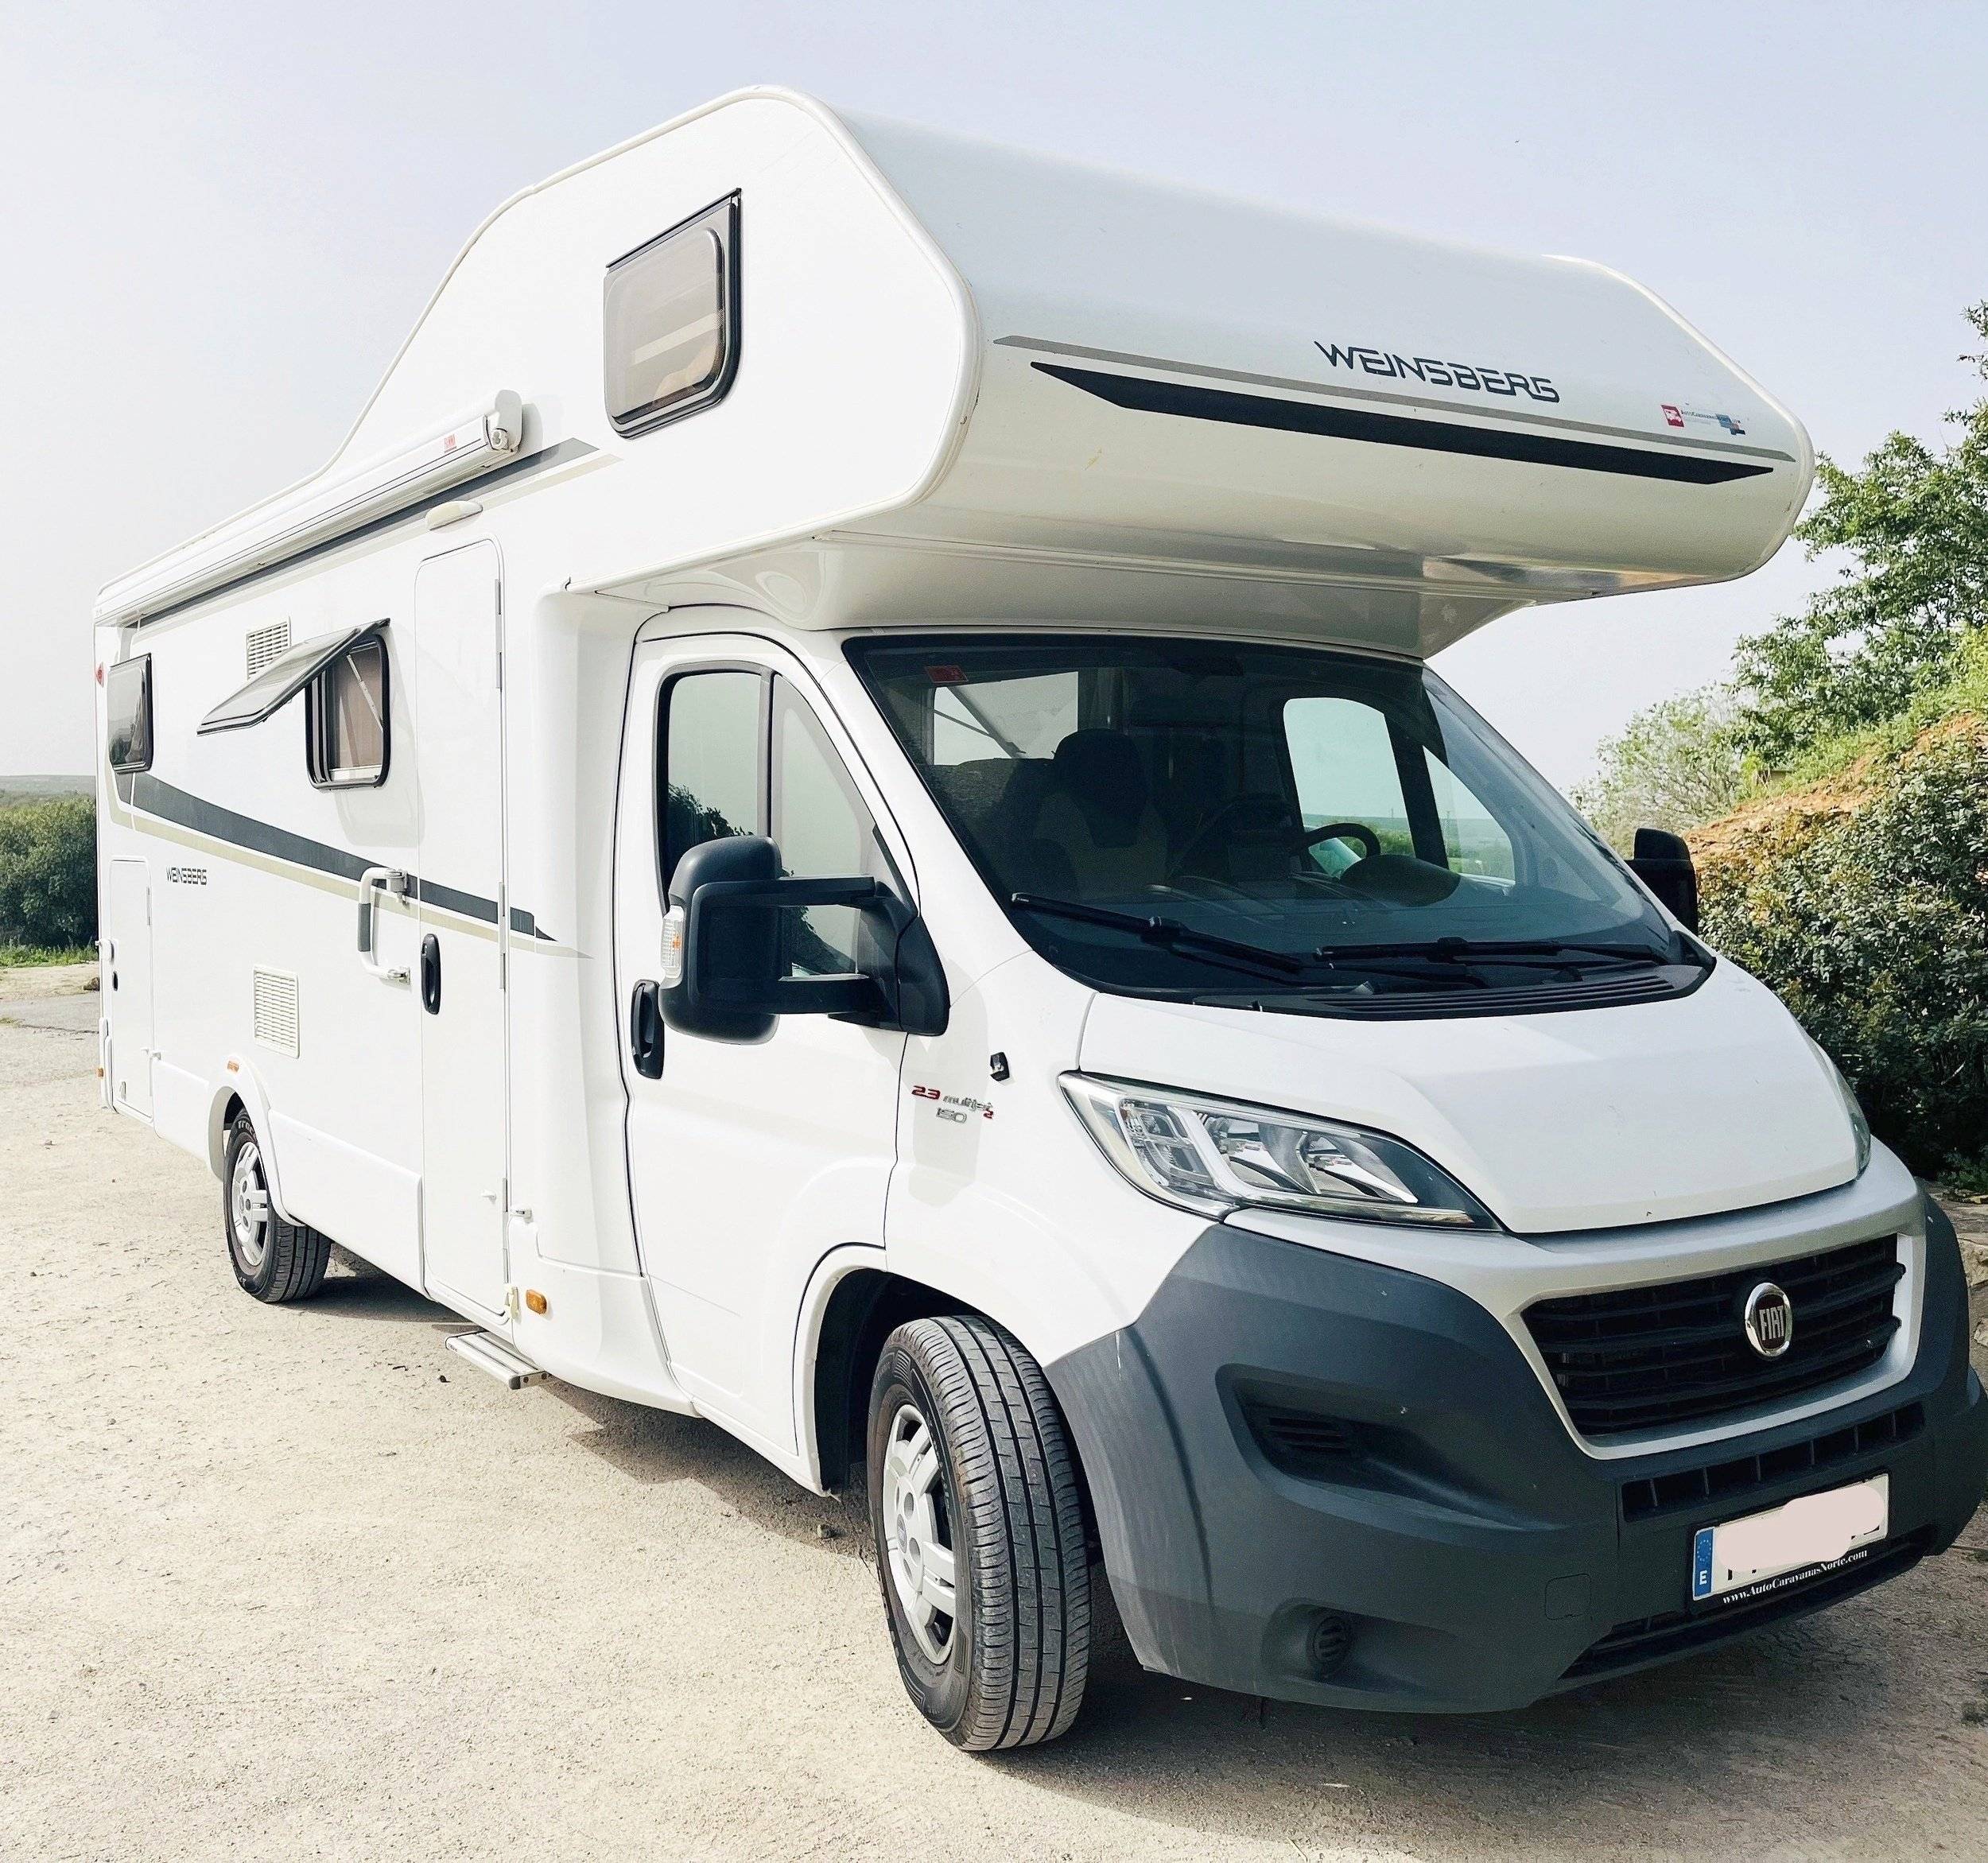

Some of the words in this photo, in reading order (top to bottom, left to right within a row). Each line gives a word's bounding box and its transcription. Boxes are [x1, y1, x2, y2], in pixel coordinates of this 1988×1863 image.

[1314, 340, 1560, 403] WEINSBERG
[165, 867, 207, 885] WEINSBERG
[1759, 1305, 1784, 1341] FIAT
[1699, 1570, 1708, 1585] E
[1723, 1550, 1868, 1604] www.AutoCaravanasNorte.com
